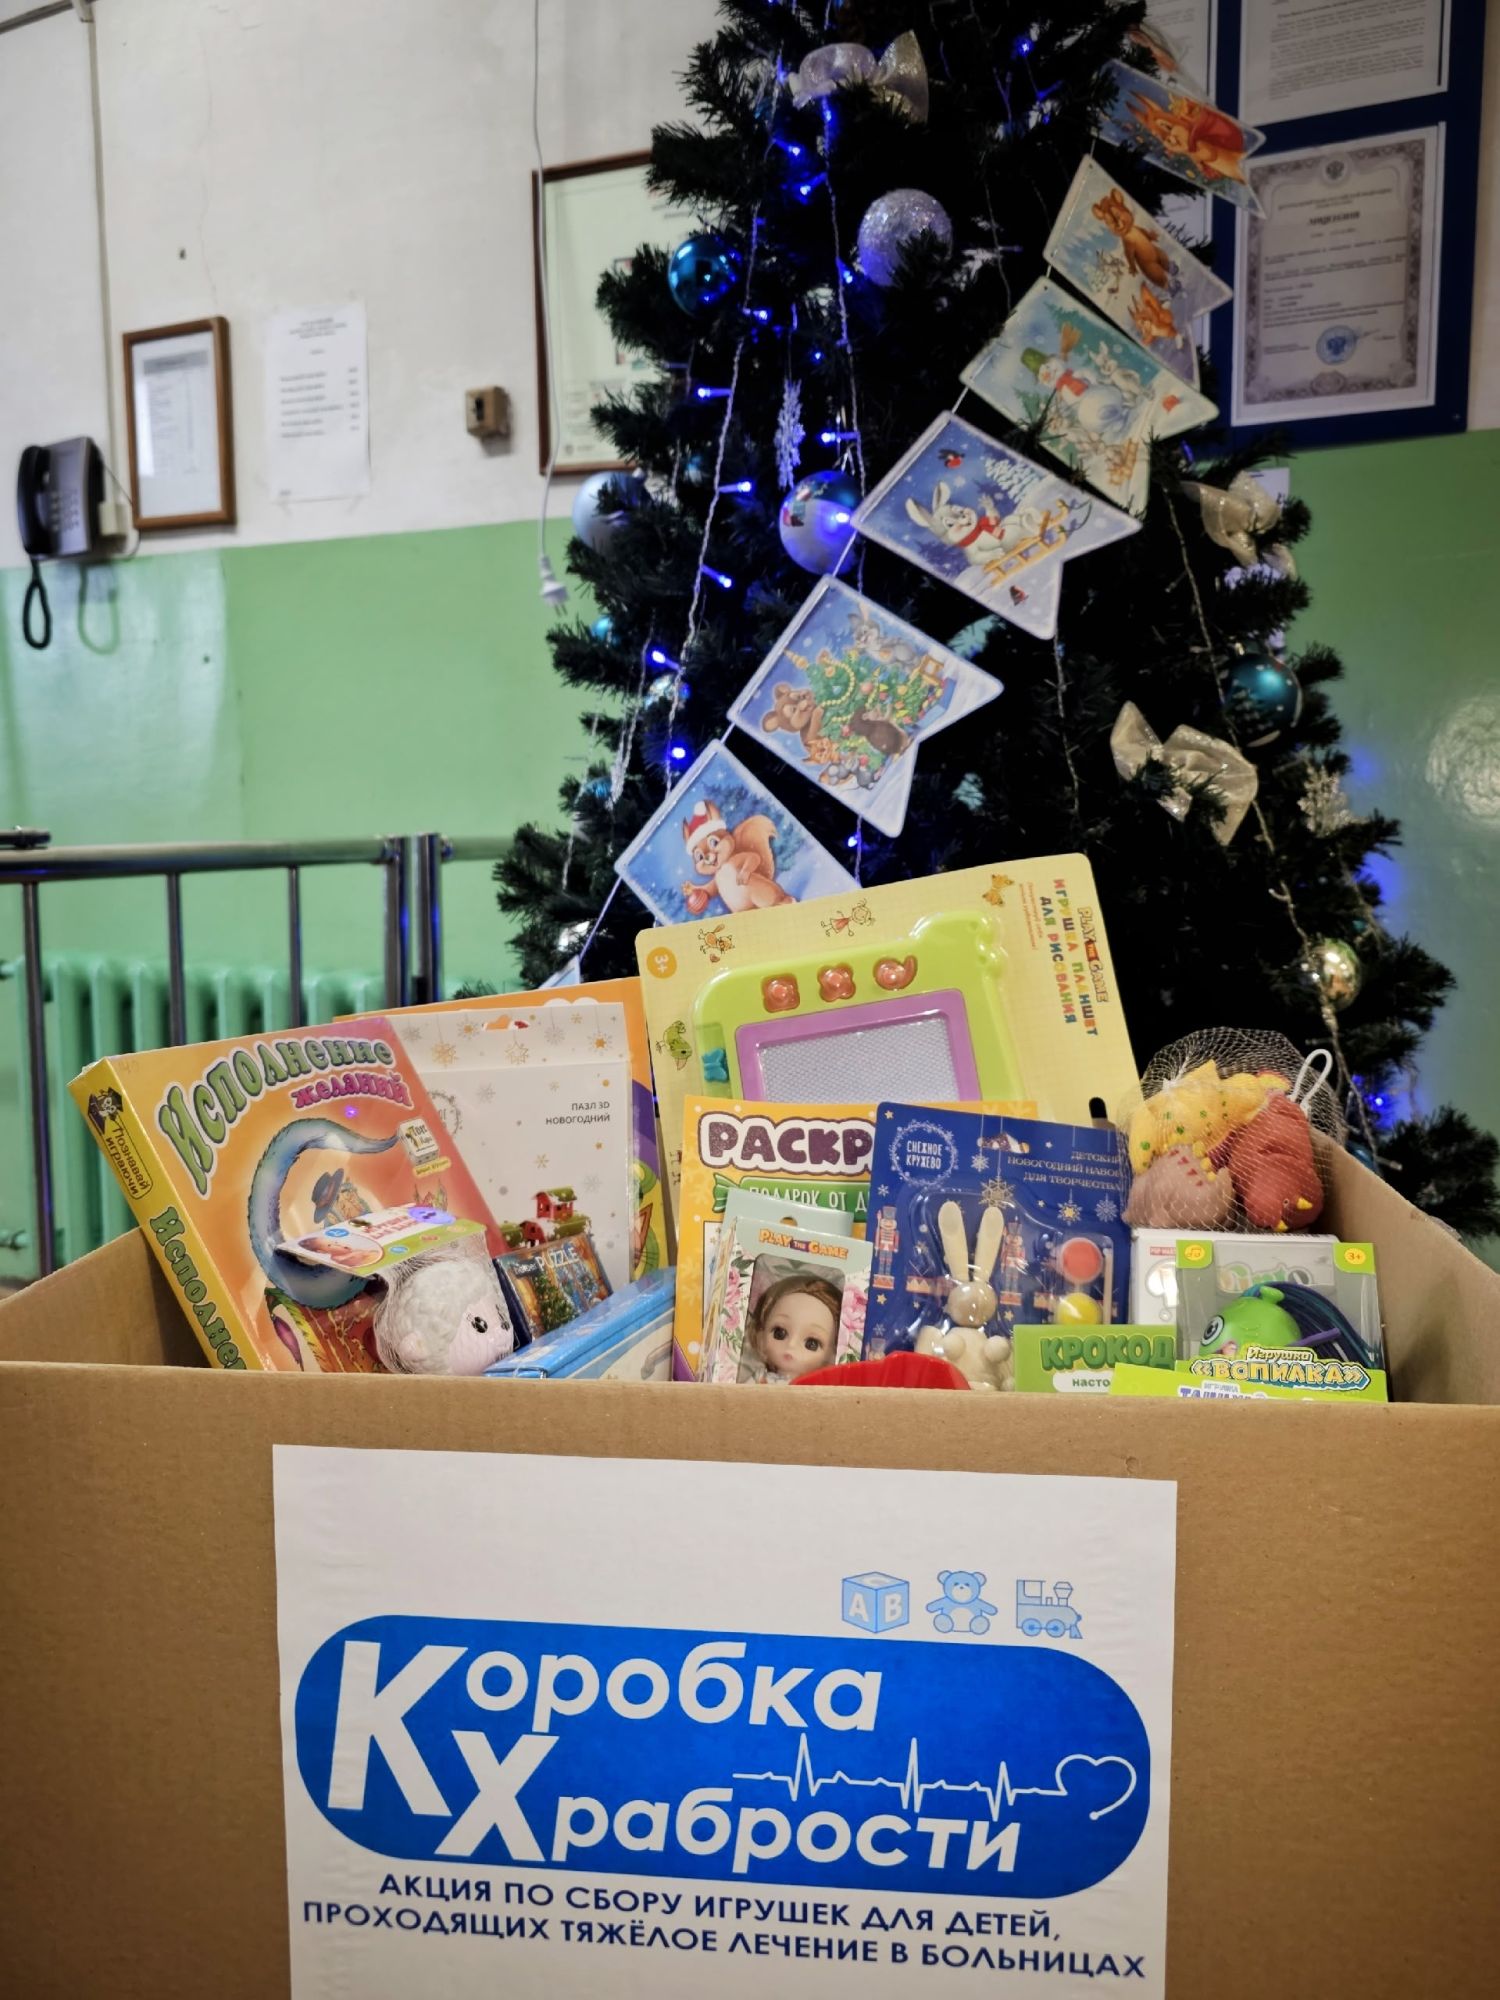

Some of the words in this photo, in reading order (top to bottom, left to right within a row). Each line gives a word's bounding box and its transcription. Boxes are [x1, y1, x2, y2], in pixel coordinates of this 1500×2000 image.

[1040, 896, 1057, 926] ДЛЯ
[1053, 879, 1079, 952] ИГРУШКА
[1072, 962, 1098, 1036] ПЛАНШЕТ
[1078, 906, 1096, 943] PLAY
[1089, 959, 1109, 1003] GAME
[1047, 933, 1078, 1024] РИСОВАНИЯ
[545, 1112, 610, 1125] НОВОГОДНИЙ
[571, 1102, 597, 1111] ПАЗЛ
[598, 1101, 610, 1109] 3D
[112, 1125, 151, 1190] Познавай
[906, 1140, 943, 1156] СНЕЖНОЕ
[906, 1154, 942, 1170] КРУЖЕВО
[105, 1137, 139, 1195] играючи
[1007, 1155, 1084, 1173] НОВОГОДНИЙ
[1023, 1171, 1048, 1183] ДЛЯ
[1049, 1175, 1123, 1192] ТВОРЧЕСТВА
[828, 1191, 846, 1211] ОТ
[758, 1228, 792, 1249] PLAY
[793, 1242, 807, 1251] THE
[808, 1240, 849, 1259] GAME
[1347, 1251, 1362, 1261] 3+
[1248, 1347, 1311, 1362] Игрушка
[1192, 1359, 1363, 1386] «ВОПИЛКА»
[327, 1640, 883, 1816] Коробка
[433, 1730, 1022, 1875] Храбрости
[379, 1873, 492, 1902] АКЦИЯ
[504, 1882, 554, 1906] ПО
[565, 1887, 683, 1915] СБОРУ
[694, 1895, 850, 1927] ИГРУШЕК
[861, 1906, 934, 1932] ДЛЯ
[945, 1909, 1061, 1942] ДЕТЕЙ,
[302, 1901, 550, 1940] ПРОХОДЯЩИХ
[560, 1920, 718, 1952] ТЯЖЁЛОЕ
[728, 1932, 879, 1963] ЛЕЧЕНИЕ
[891, 1942, 909, 1964] В
[922, 1944, 1146, 1978] БОЛЬНИЦАХ
